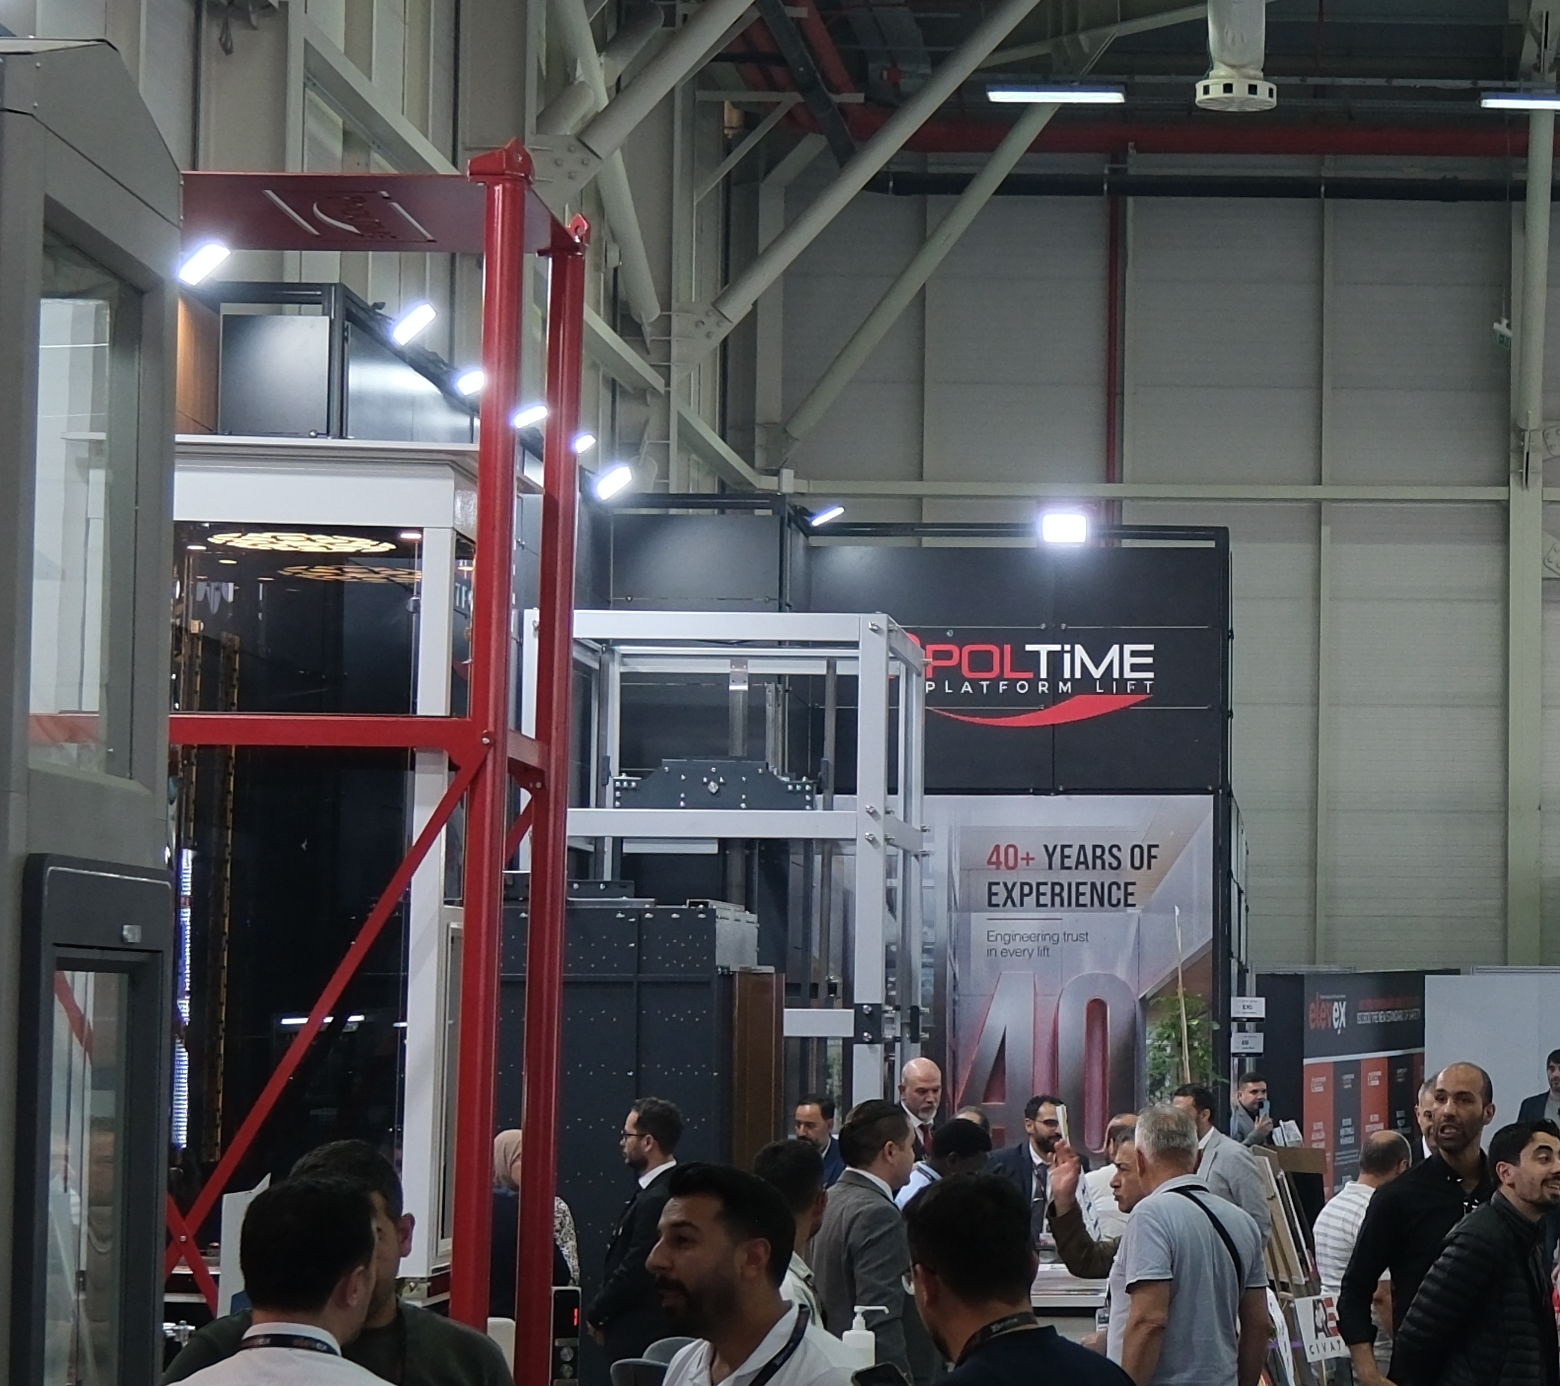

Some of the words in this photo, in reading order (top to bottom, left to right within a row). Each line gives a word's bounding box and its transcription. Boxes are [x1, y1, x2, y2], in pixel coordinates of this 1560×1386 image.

[925, 680, 1072, 694] PLATFORM
[1095, 680, 1154, 694] LIFT
[986, 843, 1036, 871] 40+
[1042, 843, 1122, 871] YEARS
[1129, 843, 1160, 871] OF
[986, 880, 1138, 909] EXPERIENCE
[986, 929, 1061, 946] Engineering
[1062, 930, 1090, 944] trust
[986, 946, 998, 958] in
[999, 948, 1035, 960] every
[1036, 946, 1051, 958] lift
[954, 970, 1138, 1154] 40
